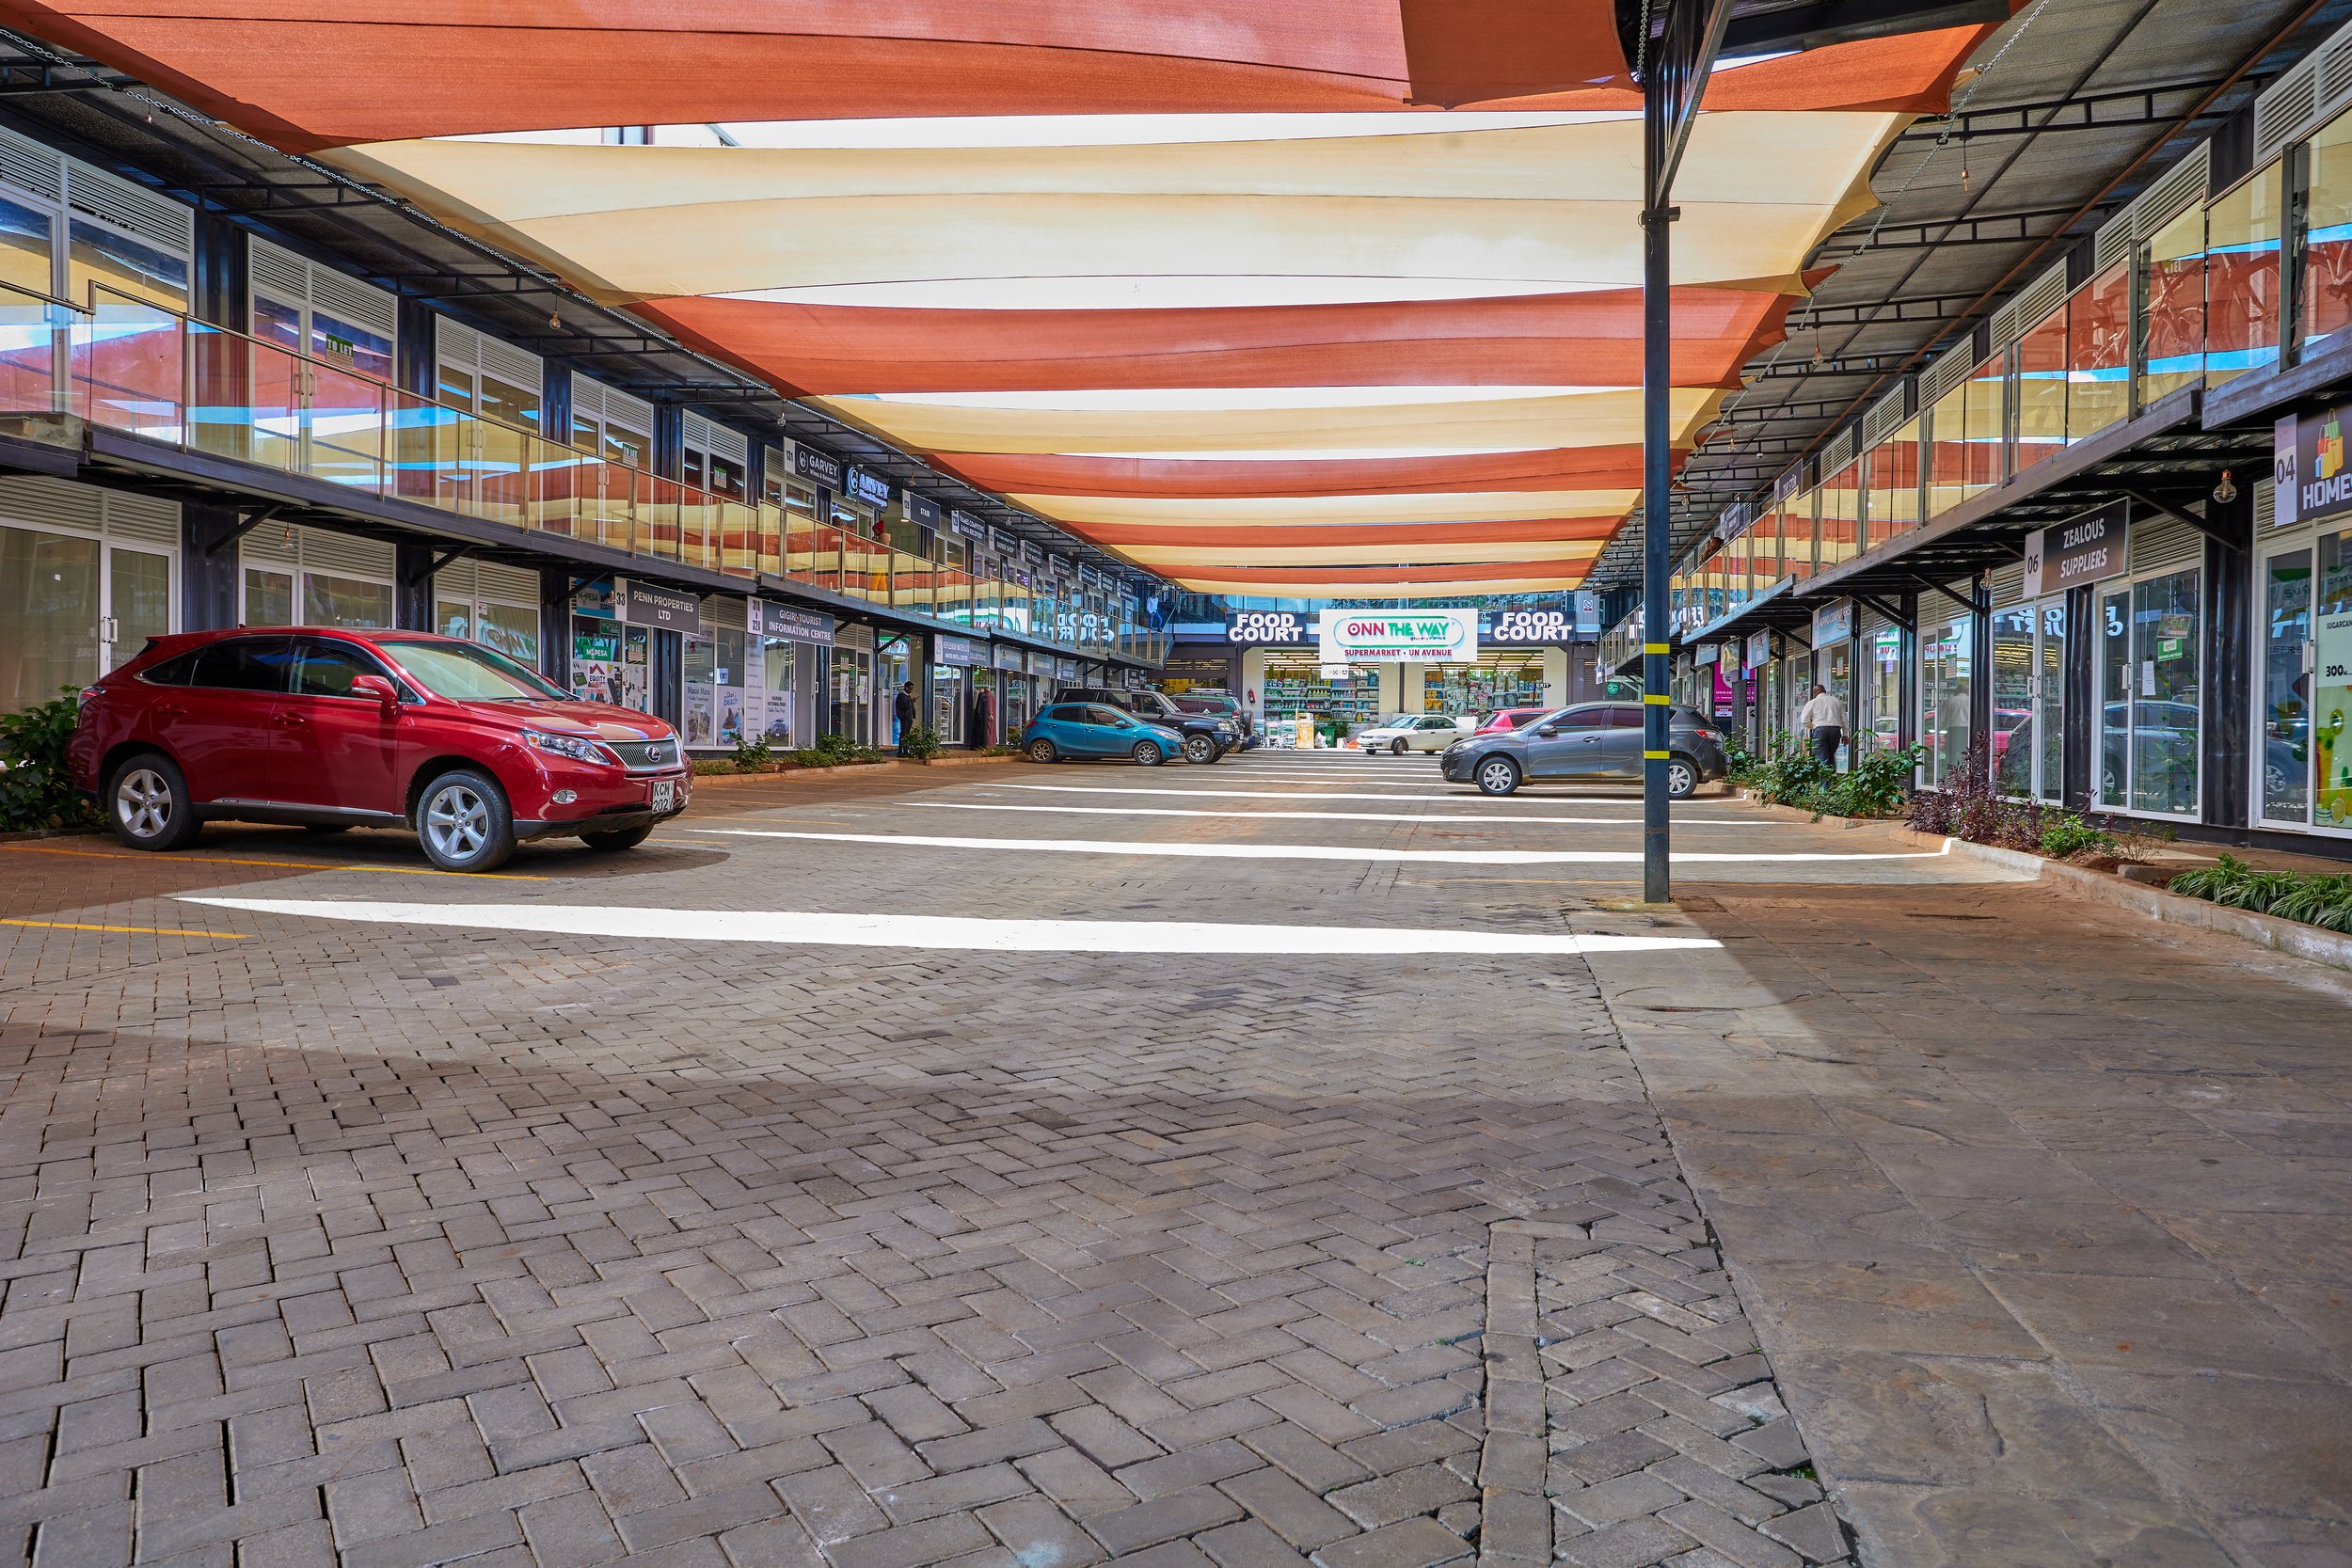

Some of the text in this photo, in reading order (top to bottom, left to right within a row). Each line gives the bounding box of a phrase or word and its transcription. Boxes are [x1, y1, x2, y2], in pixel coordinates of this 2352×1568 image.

[326, 339, 353, 356] TO LET
[809, 454, 838, 477] GARVEY
[2276, 454, 2296, 485] 04
[2302, 473, 2352, 511] HOME
[920, 507, 930, 517] STAIR
[2063, 517, 2105, 549] ZEALOUS
[2027, 553, 2039, 575] 06
[2060, 547, 2107, 578] SUPPLIERS
[616, 592, 626, 607] 33
[634, 591, 694, 612] PENN PROPERTIES
[659, 610, 671, 621] LTD
[798, 613, 822, 626] TOURIST
[1237, 613, 1295, 628] FOOD
[1502, 611, 1565, 627] FOOD
[769, 621, 832, 641] INFORMATION CENTRE
[1229, 626, 1303, 641] COURT
[1347, 622, 1450, 636] ONN THE WAY
[1494, 625, 1572, 641] COURT
[589, 674, 606, 683] EQUITY
[687, 686, 711, 696] Masai Mara
[723, 697, 739, 706] Beach
[654, 782, 671, 797] KCM
